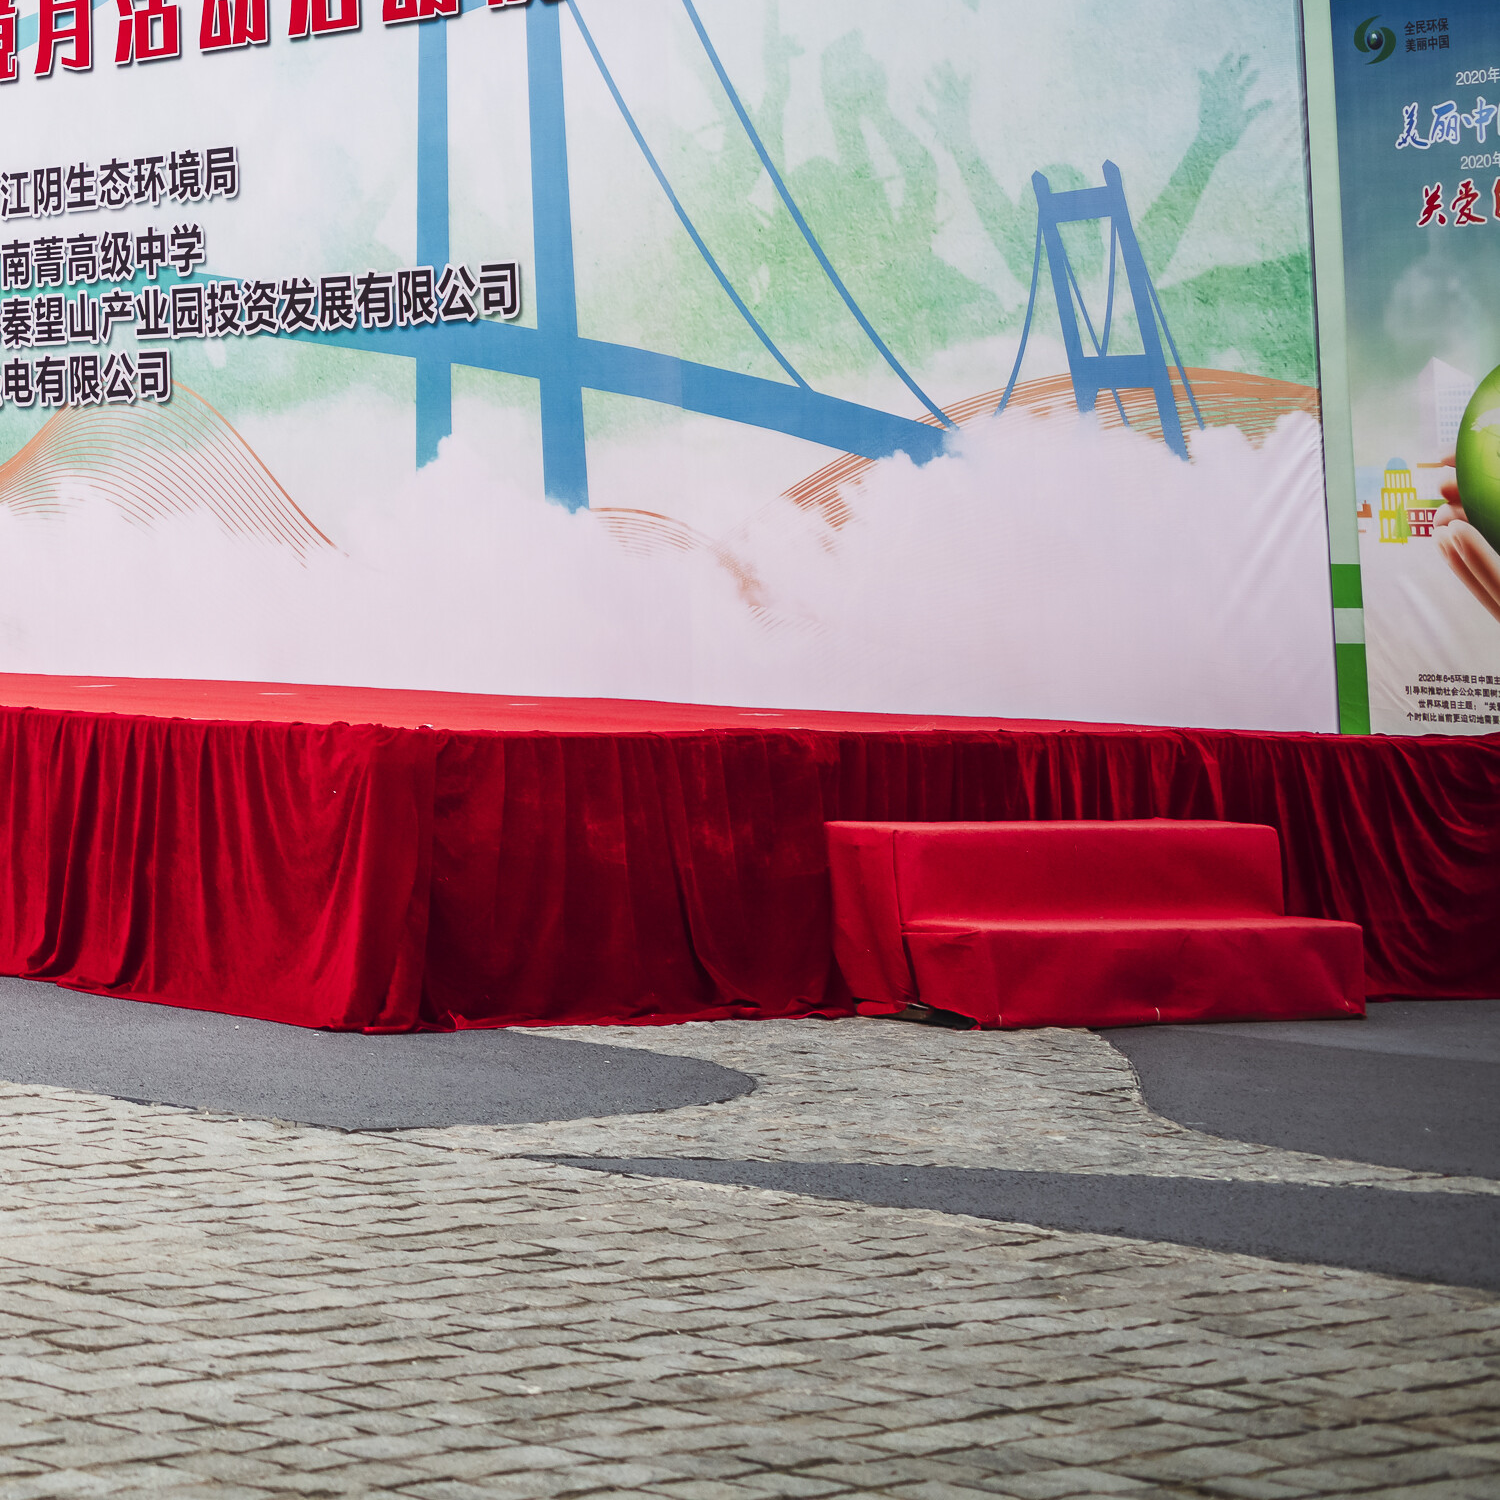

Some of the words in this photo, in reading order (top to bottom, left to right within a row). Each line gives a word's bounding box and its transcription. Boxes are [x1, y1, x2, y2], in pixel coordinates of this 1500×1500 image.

[1404, 17, 1449, 36] 全民环保
[1405, 35, 1450, 53] 美丽中国
[1455, 66, 1500, 86] 2020年
[1395, 96, 1500, 149] 美丽中
[1416, 177, 1500, 227] 关爱
[1405, 686, 1500, 698] 引导和推动社会公众牢固树
